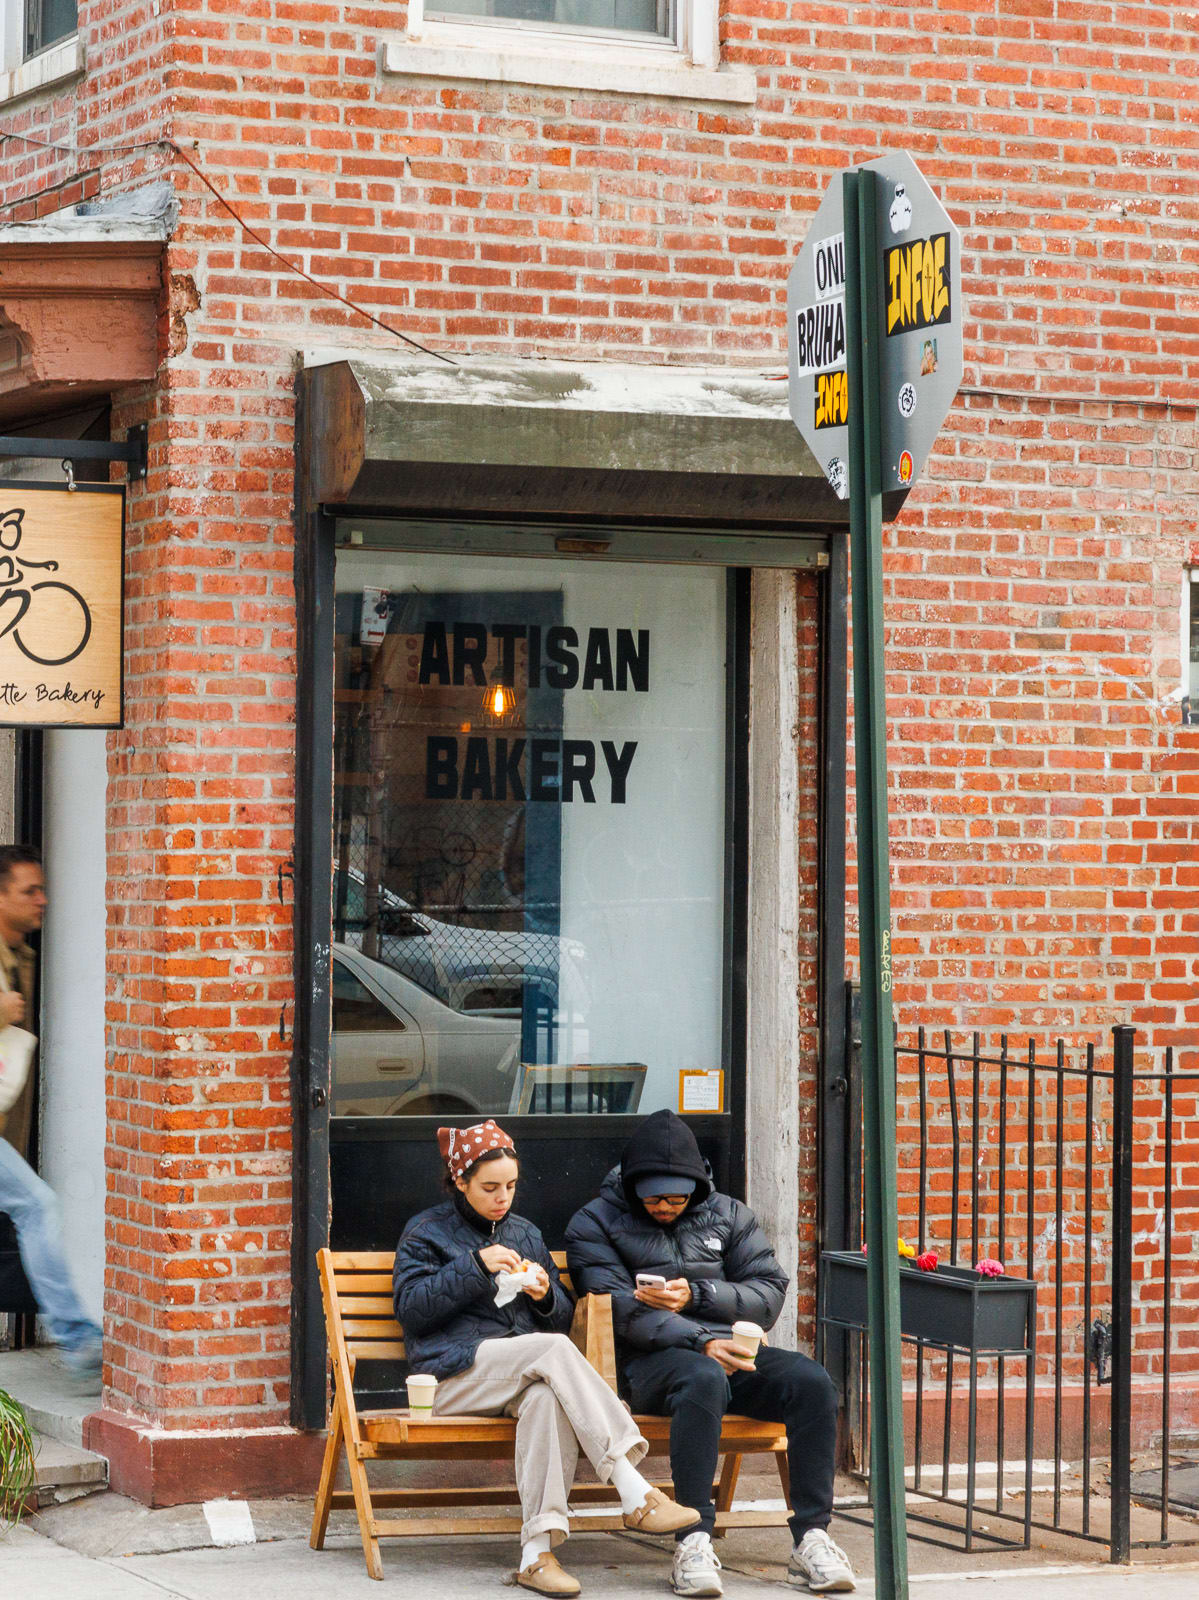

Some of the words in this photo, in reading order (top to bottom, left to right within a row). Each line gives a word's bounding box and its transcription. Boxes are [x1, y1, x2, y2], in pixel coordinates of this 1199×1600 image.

[418, 621, 650, 692] ARTISAN
[35, 682, 106, 709] Bakery
[426, 736, 639, 804] BAKERY
